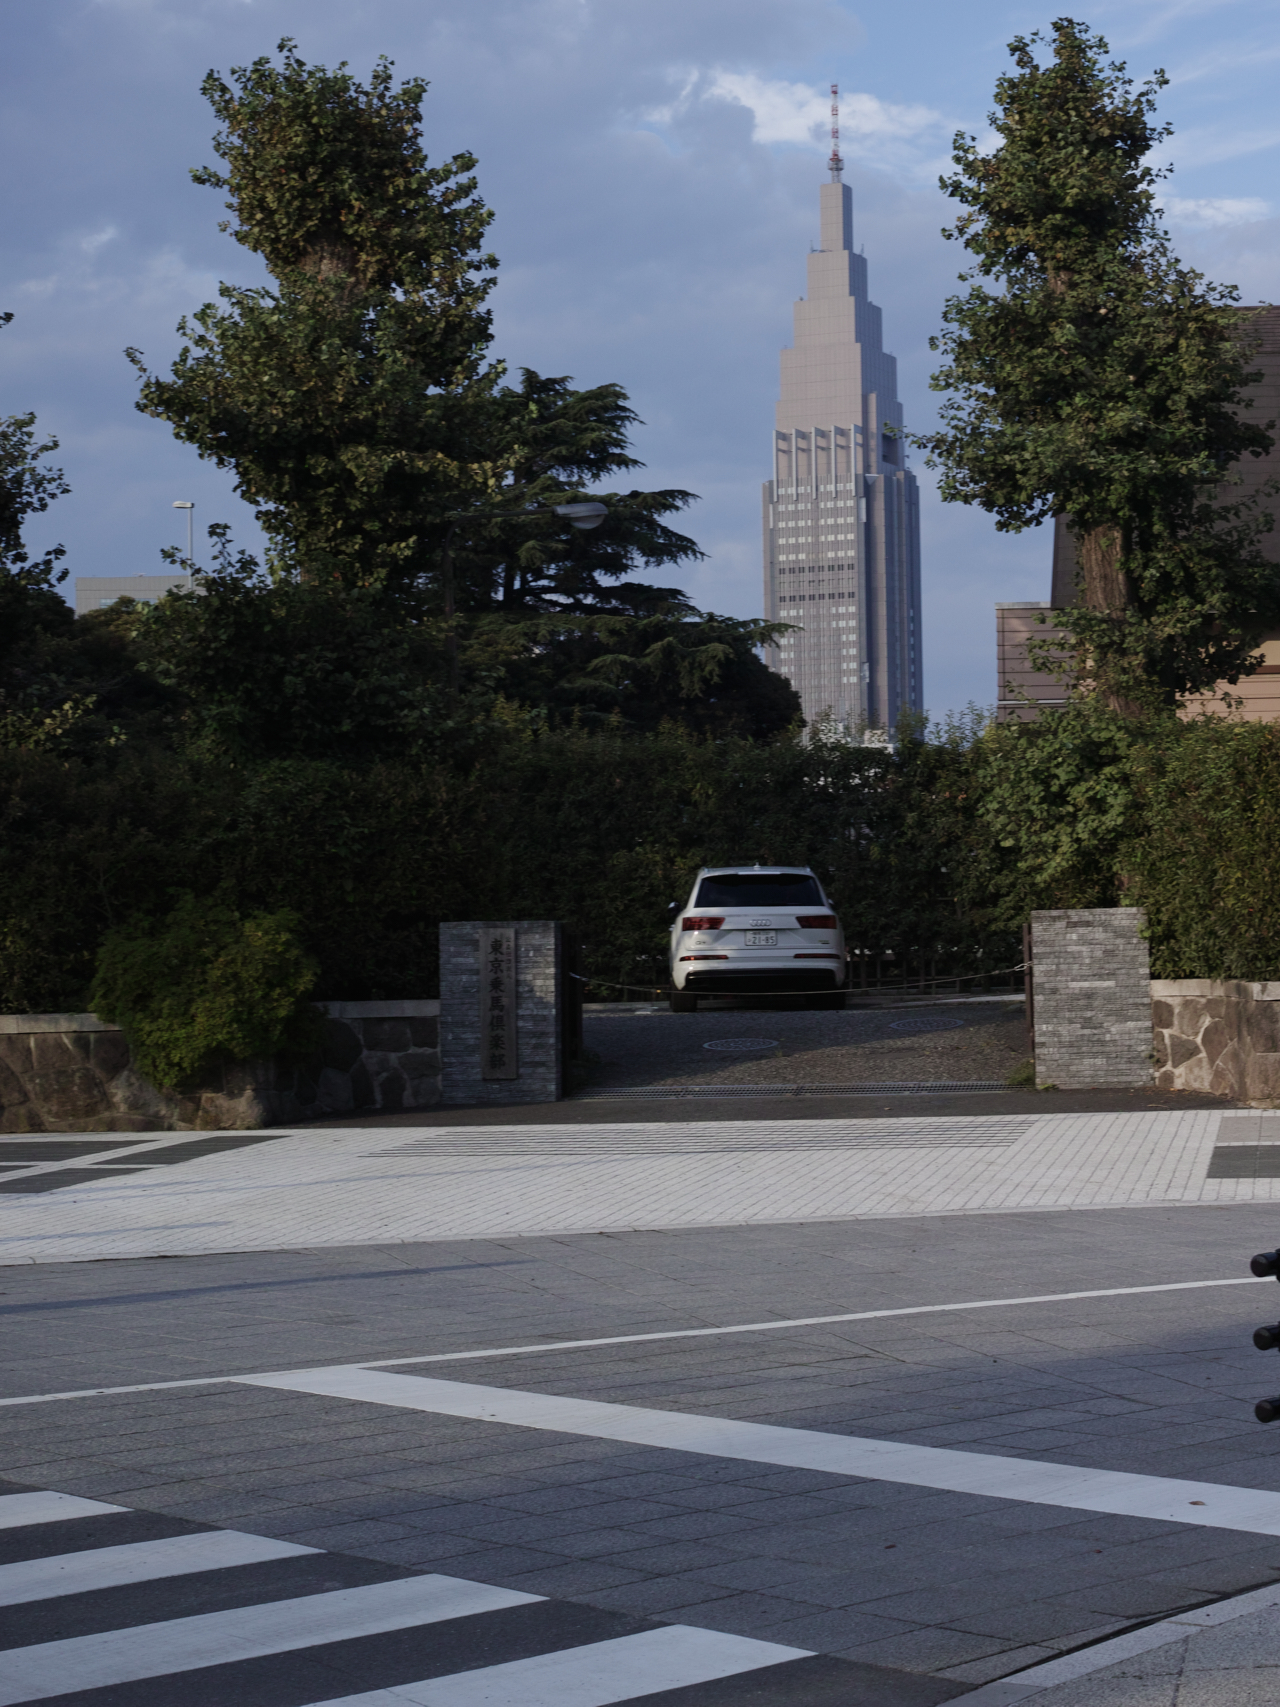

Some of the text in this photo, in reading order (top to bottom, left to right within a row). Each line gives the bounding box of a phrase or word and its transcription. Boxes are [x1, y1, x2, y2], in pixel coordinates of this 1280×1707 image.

[488, 938, 506, 1070] 東京乗馬倶楽部
